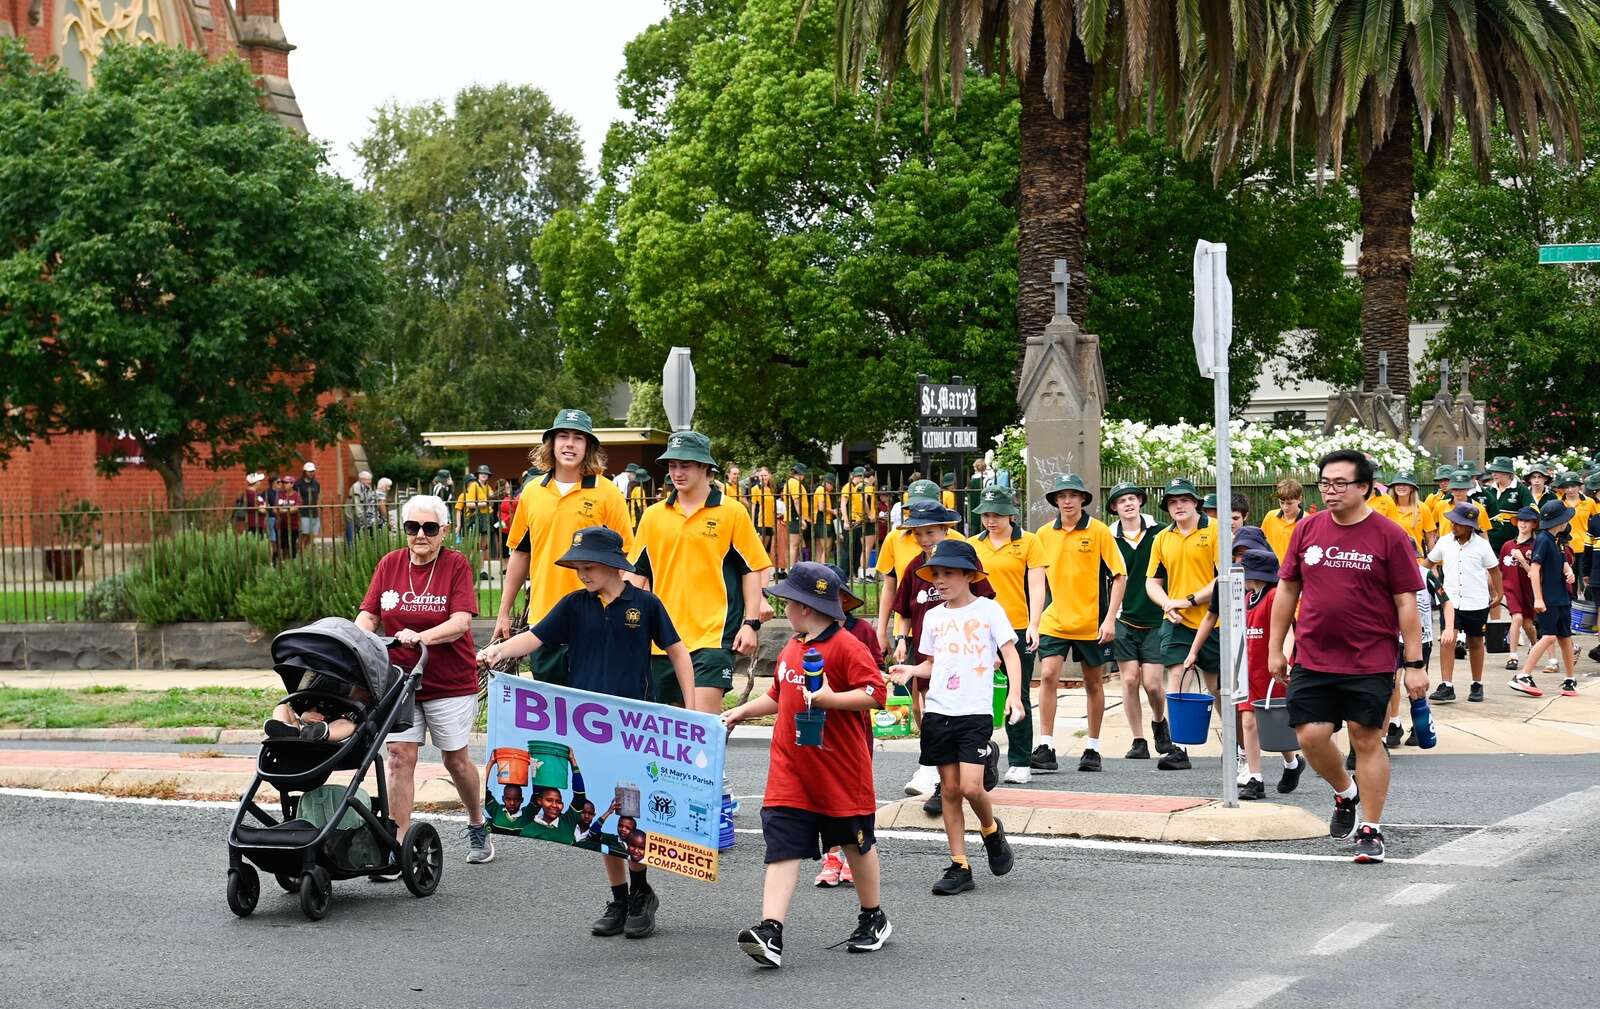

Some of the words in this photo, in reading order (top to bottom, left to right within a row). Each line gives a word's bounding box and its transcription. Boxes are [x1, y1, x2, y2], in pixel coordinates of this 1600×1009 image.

[937, 386, 976, 415] Mary's
[922, 431, 952, 448] CATHOLIC
[953, 431, 977, 448] CHURCH
[1325, 546, 1373, 563] Caritas
[1323, 559, 1371, 571] AUSTRALIA
[402, 591, 447, 604] Caritas
[400, 604, 446, 612] AUSTRALIA
[503, 685, 512, 704] THE
[515, 687, 613, 744] BIG
[618, 709, 706, 744] WATER
[620, 731, 693, 765] WALK
[660, 766, 668, 774] St
[669, 769, 692, 780] Mary's
[692, 774, 714, 786] Parish
[649, 842, 714, 869] PROJECT
[677, 842, 714, 857] AUSTRALIA
[647, 855, 714, 880] COMPASSION
